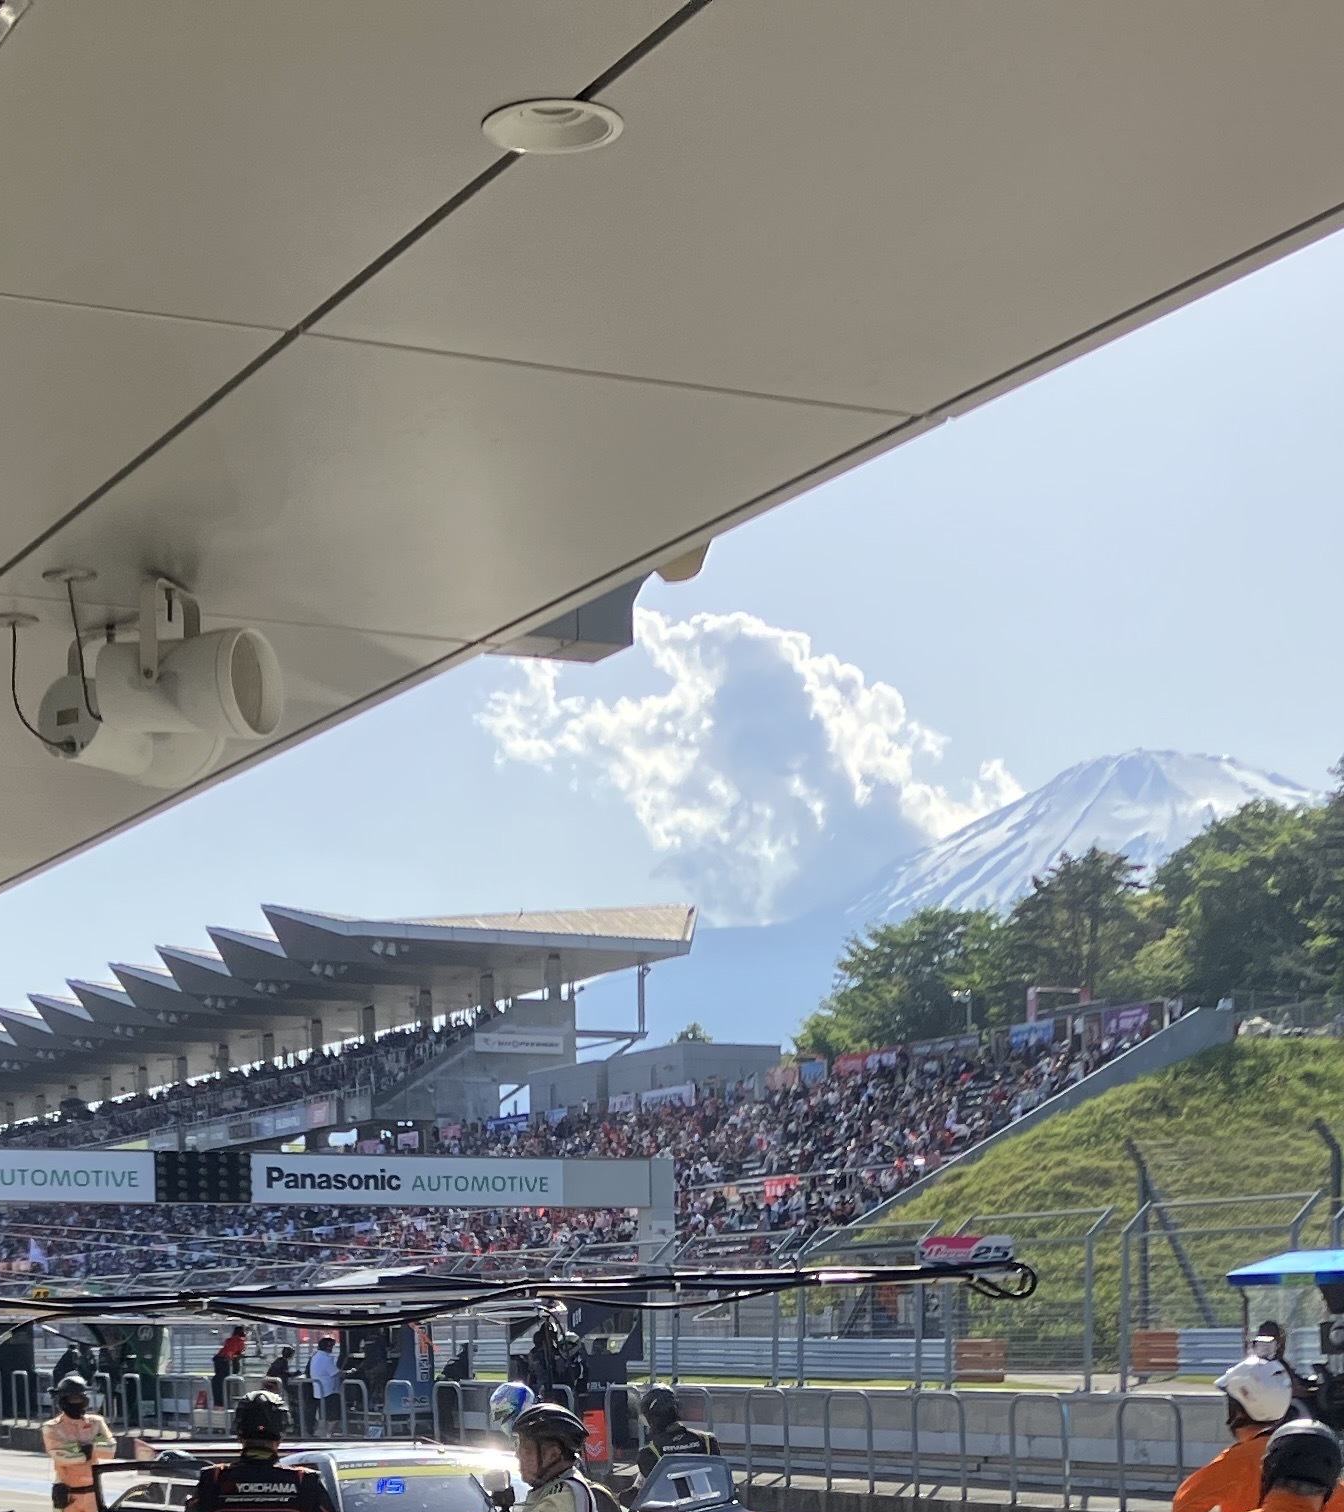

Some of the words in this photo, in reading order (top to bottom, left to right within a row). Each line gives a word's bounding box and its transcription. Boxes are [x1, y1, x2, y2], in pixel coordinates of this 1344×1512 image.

[265, 1166, 401, 1191] Panasonic
[411, 1174, 549, 1193] AUTOMOTIVE
[971, 1245, 1014, 1261] 25
[236, 1482, 298, 1493] YOKOHAMA
